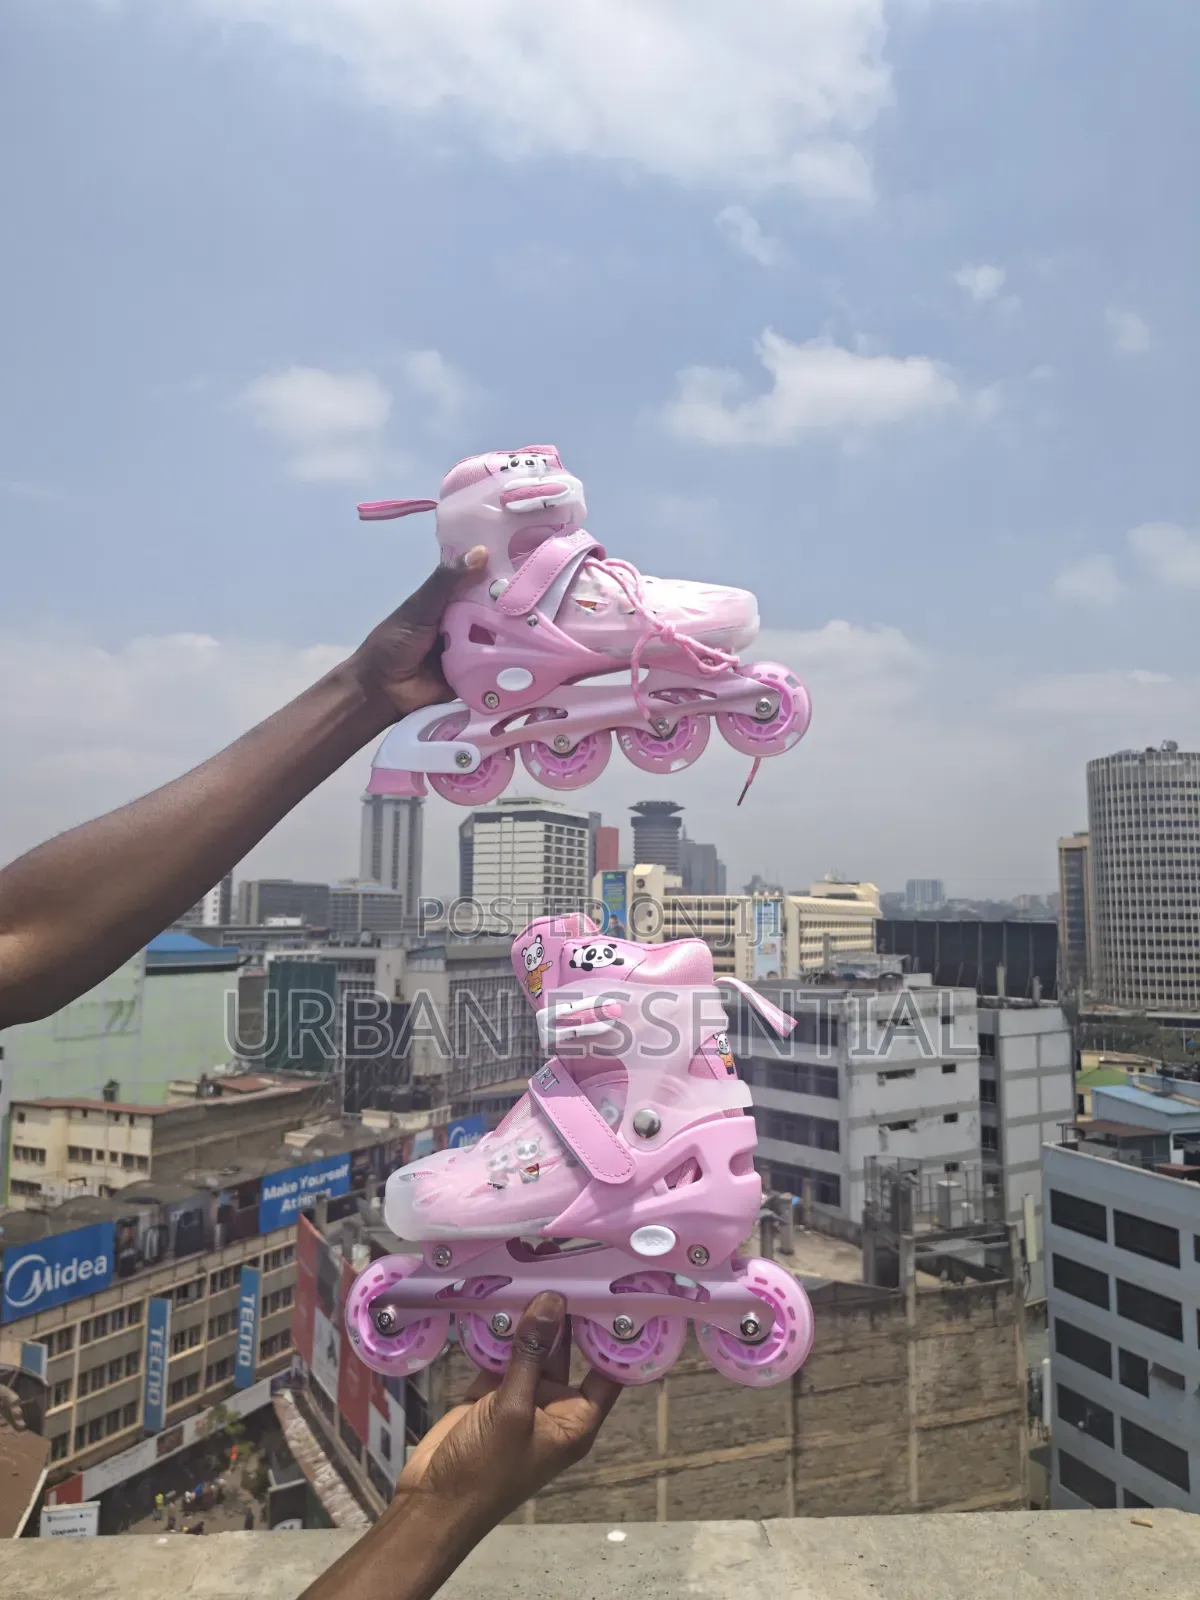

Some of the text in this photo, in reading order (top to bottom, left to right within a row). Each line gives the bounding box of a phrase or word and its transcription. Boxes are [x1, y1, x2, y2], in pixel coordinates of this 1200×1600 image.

[263, 1182, 298, 1202] Make
[5, 1254, 108, 1307] Midea
[239, 1294, 255, 1367] TECNO
[148, 1325, 164, 1406] TECNO
